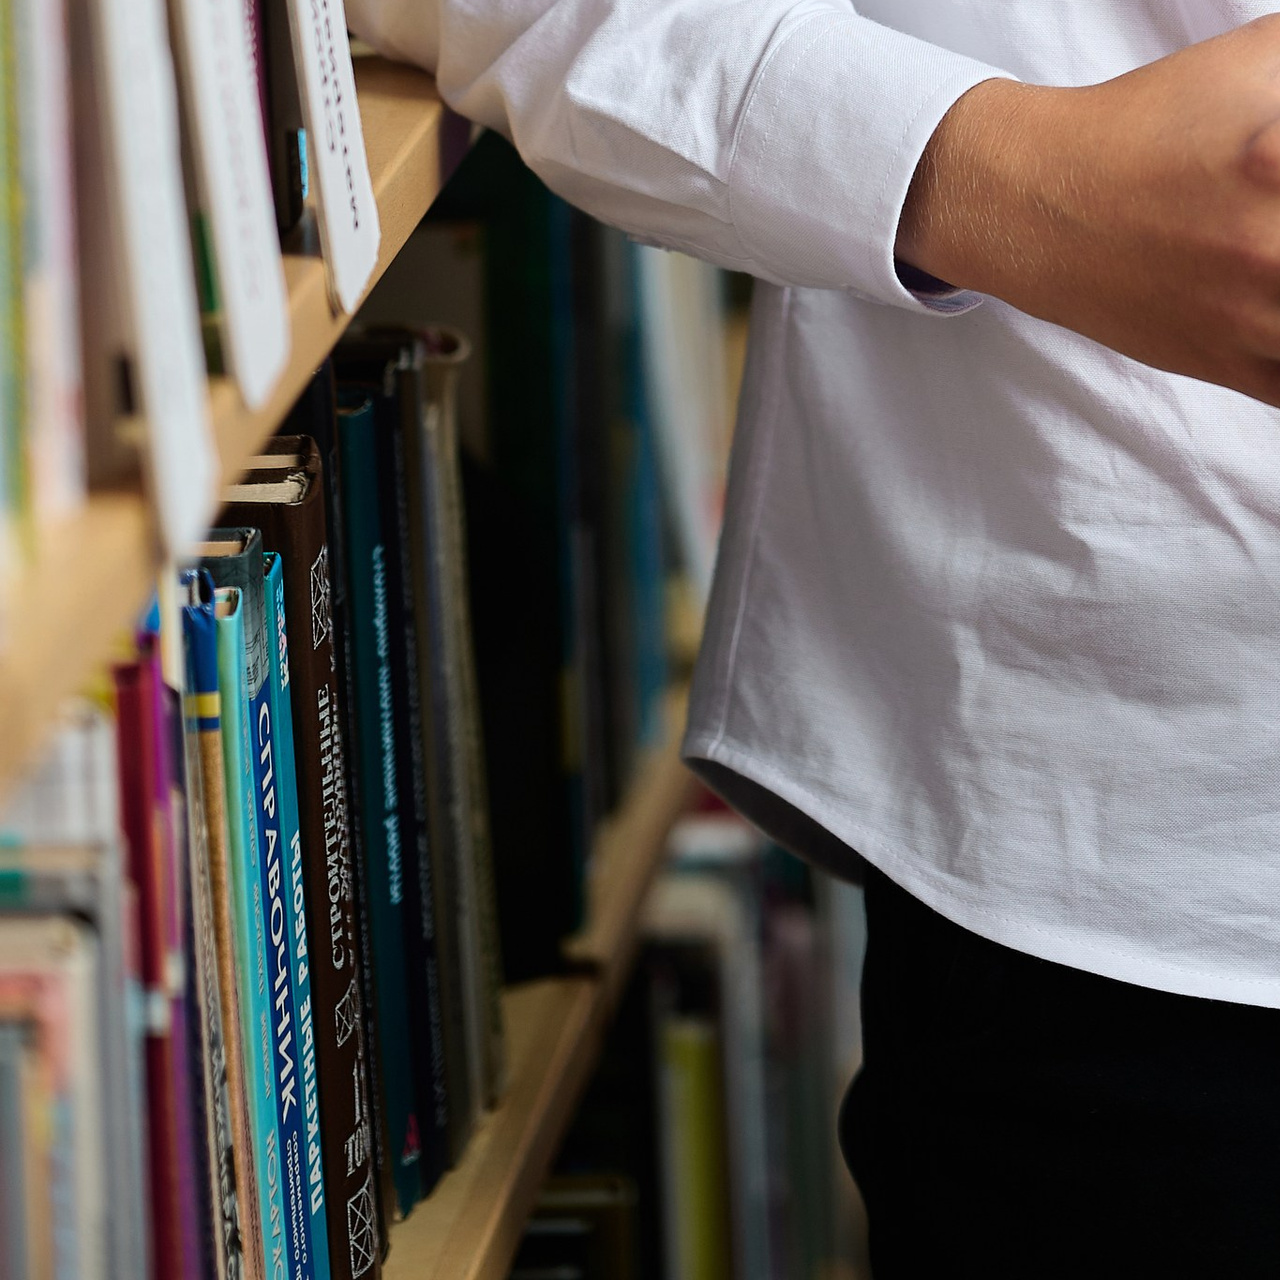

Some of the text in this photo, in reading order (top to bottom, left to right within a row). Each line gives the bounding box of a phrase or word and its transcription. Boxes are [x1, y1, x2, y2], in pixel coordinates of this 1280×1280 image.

[259, 701, 297, 1124] СПРАВОЧНИК
[318, 683, 344, 970] СТРОИТЕЛЬНЫЕ
[290, 829, 324, 1215] ПАРКЕТНЫЕ РАБОТЫ
[286, 1138, 300, 1261] строительного
[292, 1130, 308, 1264] современного
